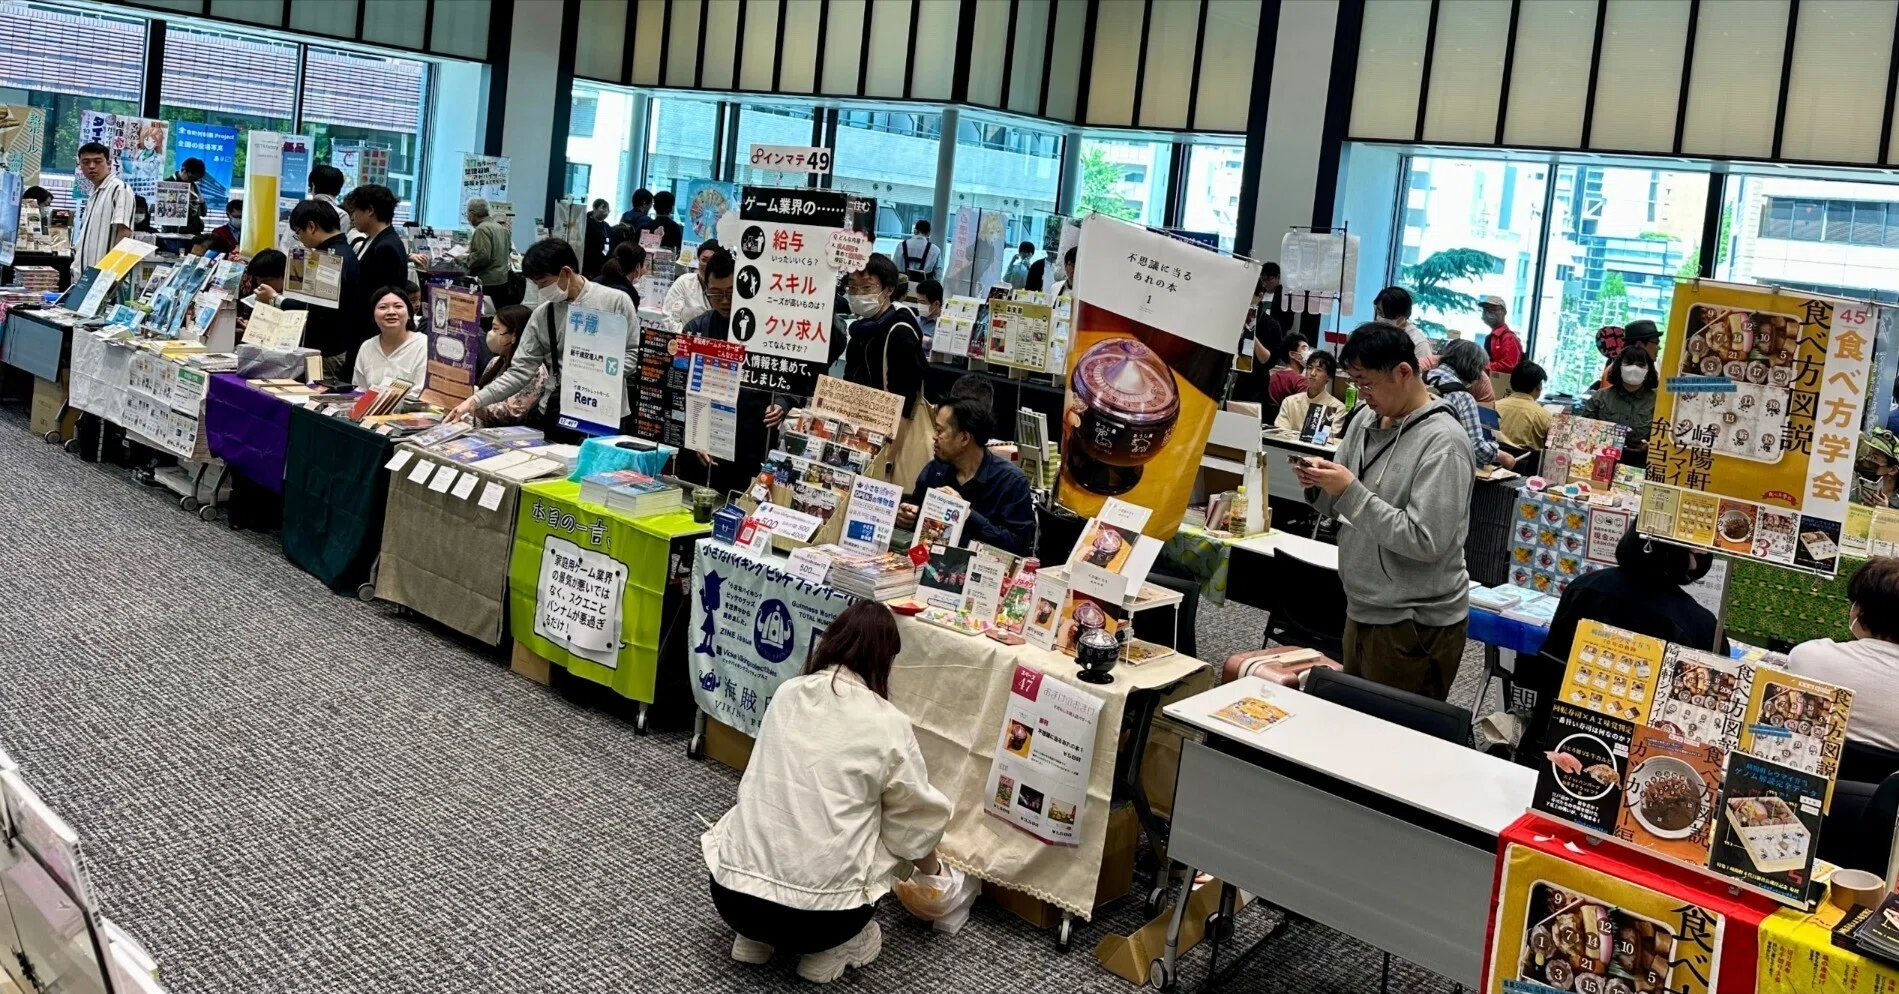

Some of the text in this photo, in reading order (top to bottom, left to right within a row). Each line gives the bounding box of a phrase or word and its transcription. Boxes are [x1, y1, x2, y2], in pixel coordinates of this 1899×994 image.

[214, 132, 235, 141] Project
[763, 151, 830, 171] インマテ 49
[772, 229, 805, 252] 給与
[1127, 252, 1193, 282] 不思議に当る
[768, 273, 818, 296] スキル
[1133, 271, 1179, 293] あれの本
[569, 310, 599, 336] 千歳
[1839, 308, 1867, 325] 45
[763, 315, 828, 343] クソ求人
[570, 349, 604, 363] 新千歳空港入門
[1779, 298, 1835, 456] 食べ方図説
[574, 391, 598, 408] Rera
[1811, 329, 1869, 504] 食べ方学会
[1644, 416, 1674, 485] 弁当編
[1667, 423, 1693, 486] シウマイ
[1685, 423, 1719, 492] 崎陽軒
[532, 497, 612, 550] 本日の一言、
[554, 553, 614, 585] 家庭用ゲーム業界
[702, 543, 766, 577] 小さなバイキング
[766, 565, 794, 587] ビッケ
[551, 570, 610, 600] の景気が悪いでは
[549, 585, 607, 615] なく、スクエニと
[791, 600, 819, 615] Guinness
[546, 600, 607, 631] バンナムが悪過ぎ
[799, 611, 816, 623] TOTAL
[720, 627, 752, 646] ZINE issue
[1017, 677, 1034, 693] 47
[1020, 670, 1036, 681] スペース
[715, 700, 746, 722] VIKING
[1717, 663, 1757, 756] 食べ方図説
[1816, 688, 1854, 782] 食べ方図説
[1688, 745, 1725, 852] 食べ方図説
[1553, 894, 1563, 904] 9
[1566, 930, 1574, 940] 7
[1600, 920, 1612, 933] 12
[1537, 937, 1545, 948] 1
[1587, 936, 1598, 947] 14
[1621, 942, 1634, 955] 10
[1662, 904, 1718, 994] 食べ
[1554, 969, 1563, 981] 3
[1581, 958, 1594, 970] 21
[1584, 980, 1597, 992] 15
[1647, 972, 1656, 984] 5
